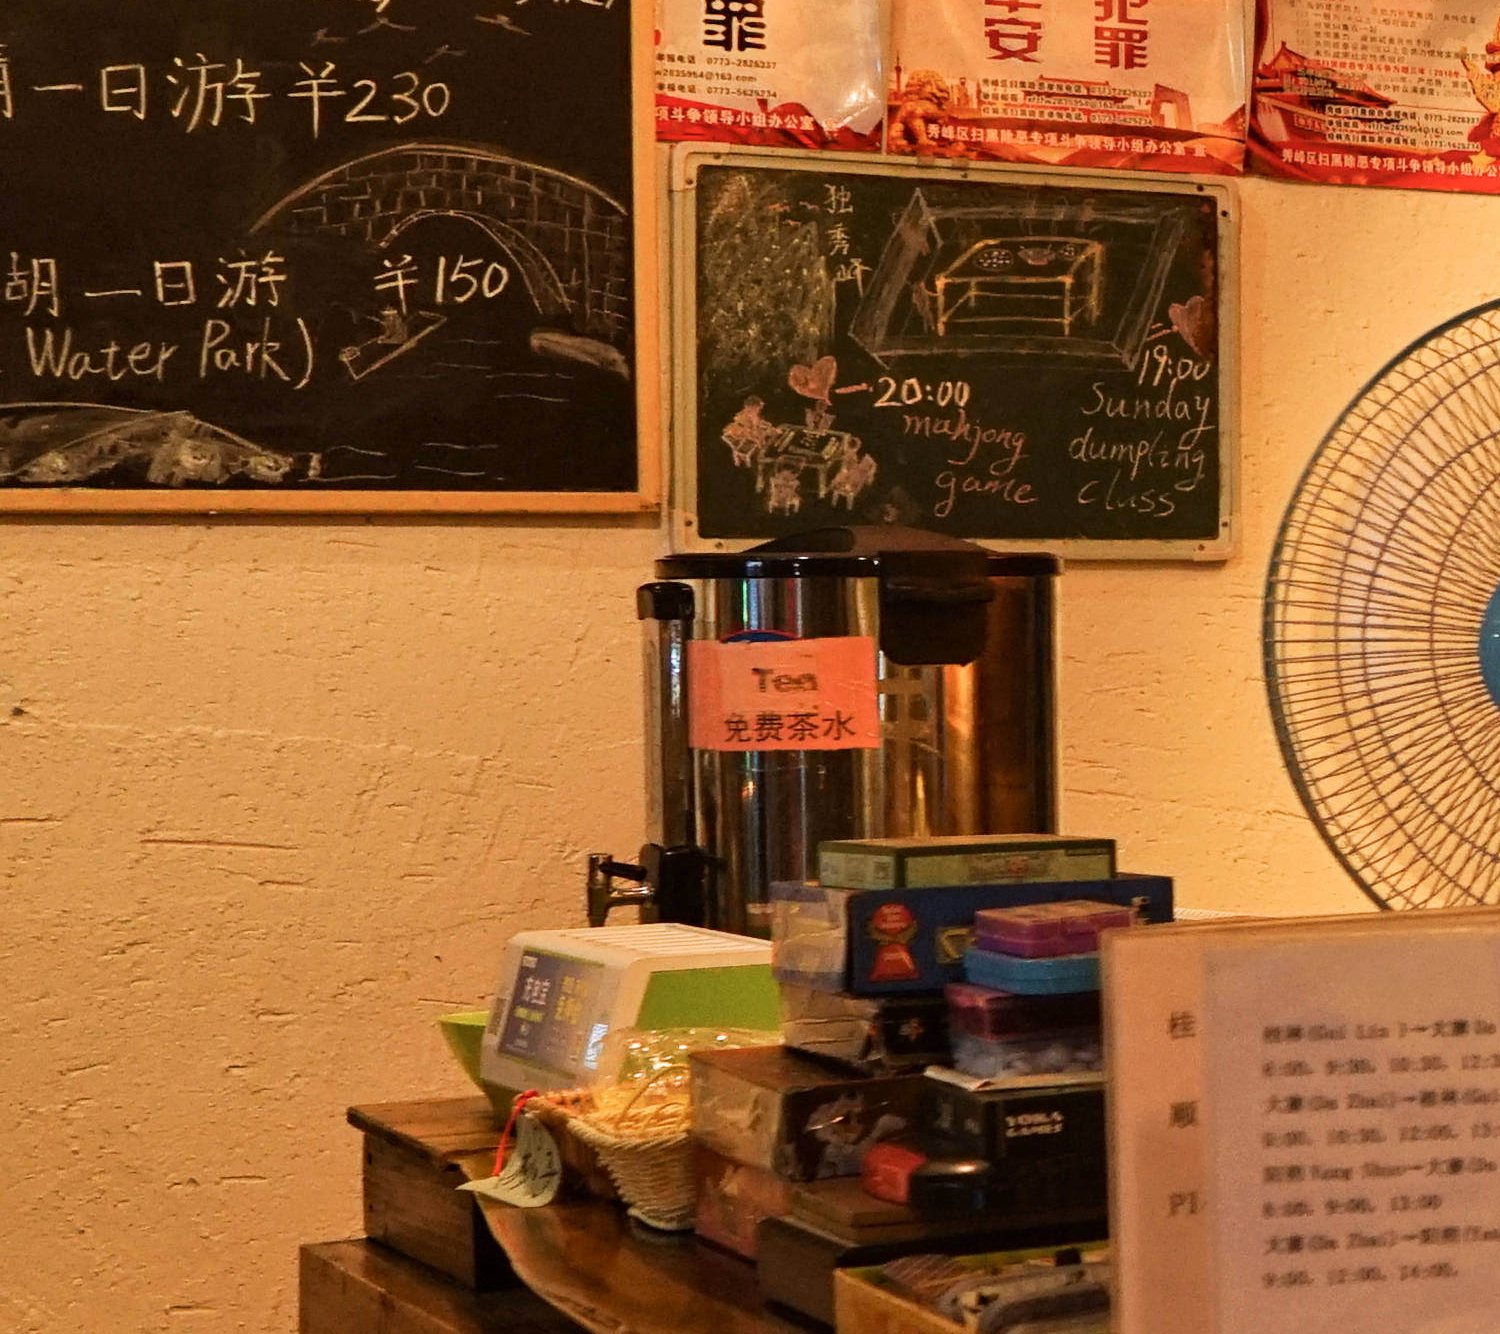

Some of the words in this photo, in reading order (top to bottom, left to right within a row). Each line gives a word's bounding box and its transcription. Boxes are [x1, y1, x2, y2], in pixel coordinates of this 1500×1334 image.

[287, 67, 452, 139] ¥230
[823, 182, 872, 298] 独秀峰
[376, 255, 509, 323] ¥150
[26, 327, 180, 382] Water
[873, 376, 970, 408] 20:00
[1081, 379, 1216, 447] Sunday
[903, 409, 1026, 475] mahjong
[1069, 427, 1207, 493] dumpling
[933, 470, 1038, 519] game
[751, 667, 820, 694] Tea
[724, 707, 856, 743] 免费茶水
